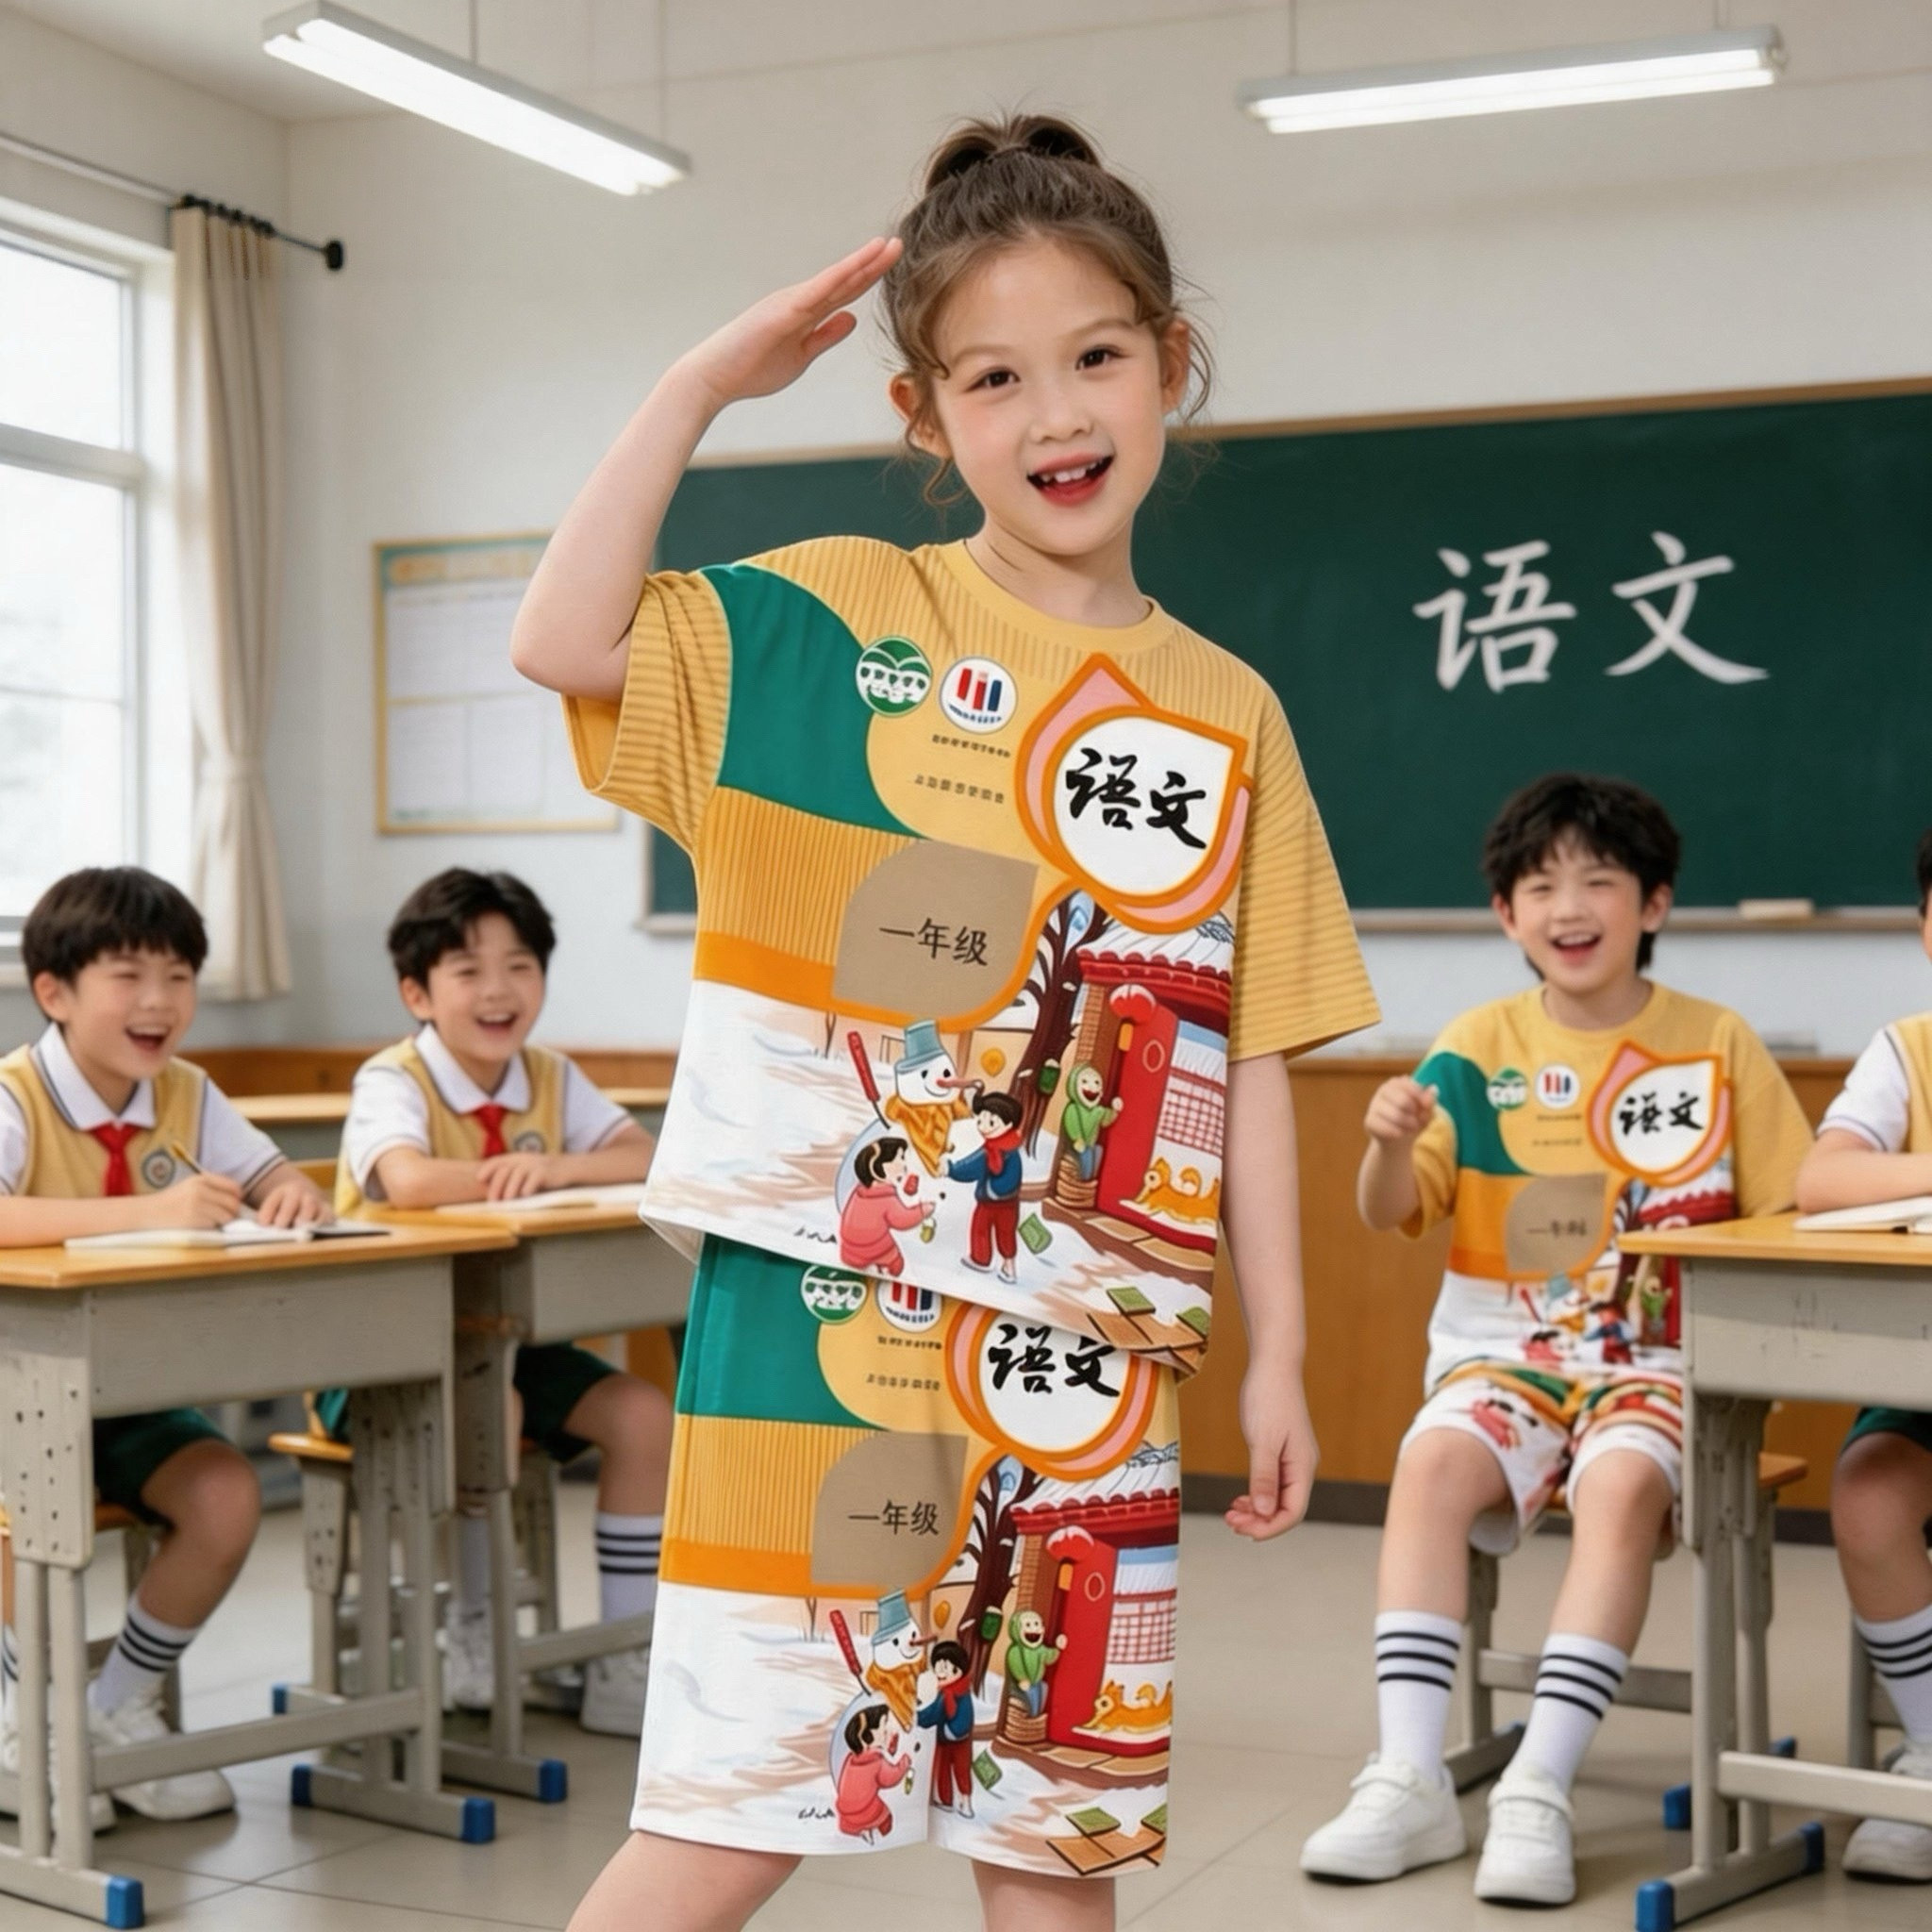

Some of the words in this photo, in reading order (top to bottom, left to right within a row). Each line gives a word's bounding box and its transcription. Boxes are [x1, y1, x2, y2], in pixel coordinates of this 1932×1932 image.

[1412, 531, 1770, 693] 语文
[1065, 747, 1208, 850] 语文
[879, 916, 989, 967] 一年级
[1618, 1091, 1705, 1137] 语文
[987, 1323, 1121, 1398] 语文
[847, 1499, 940, 1537] 一年级
